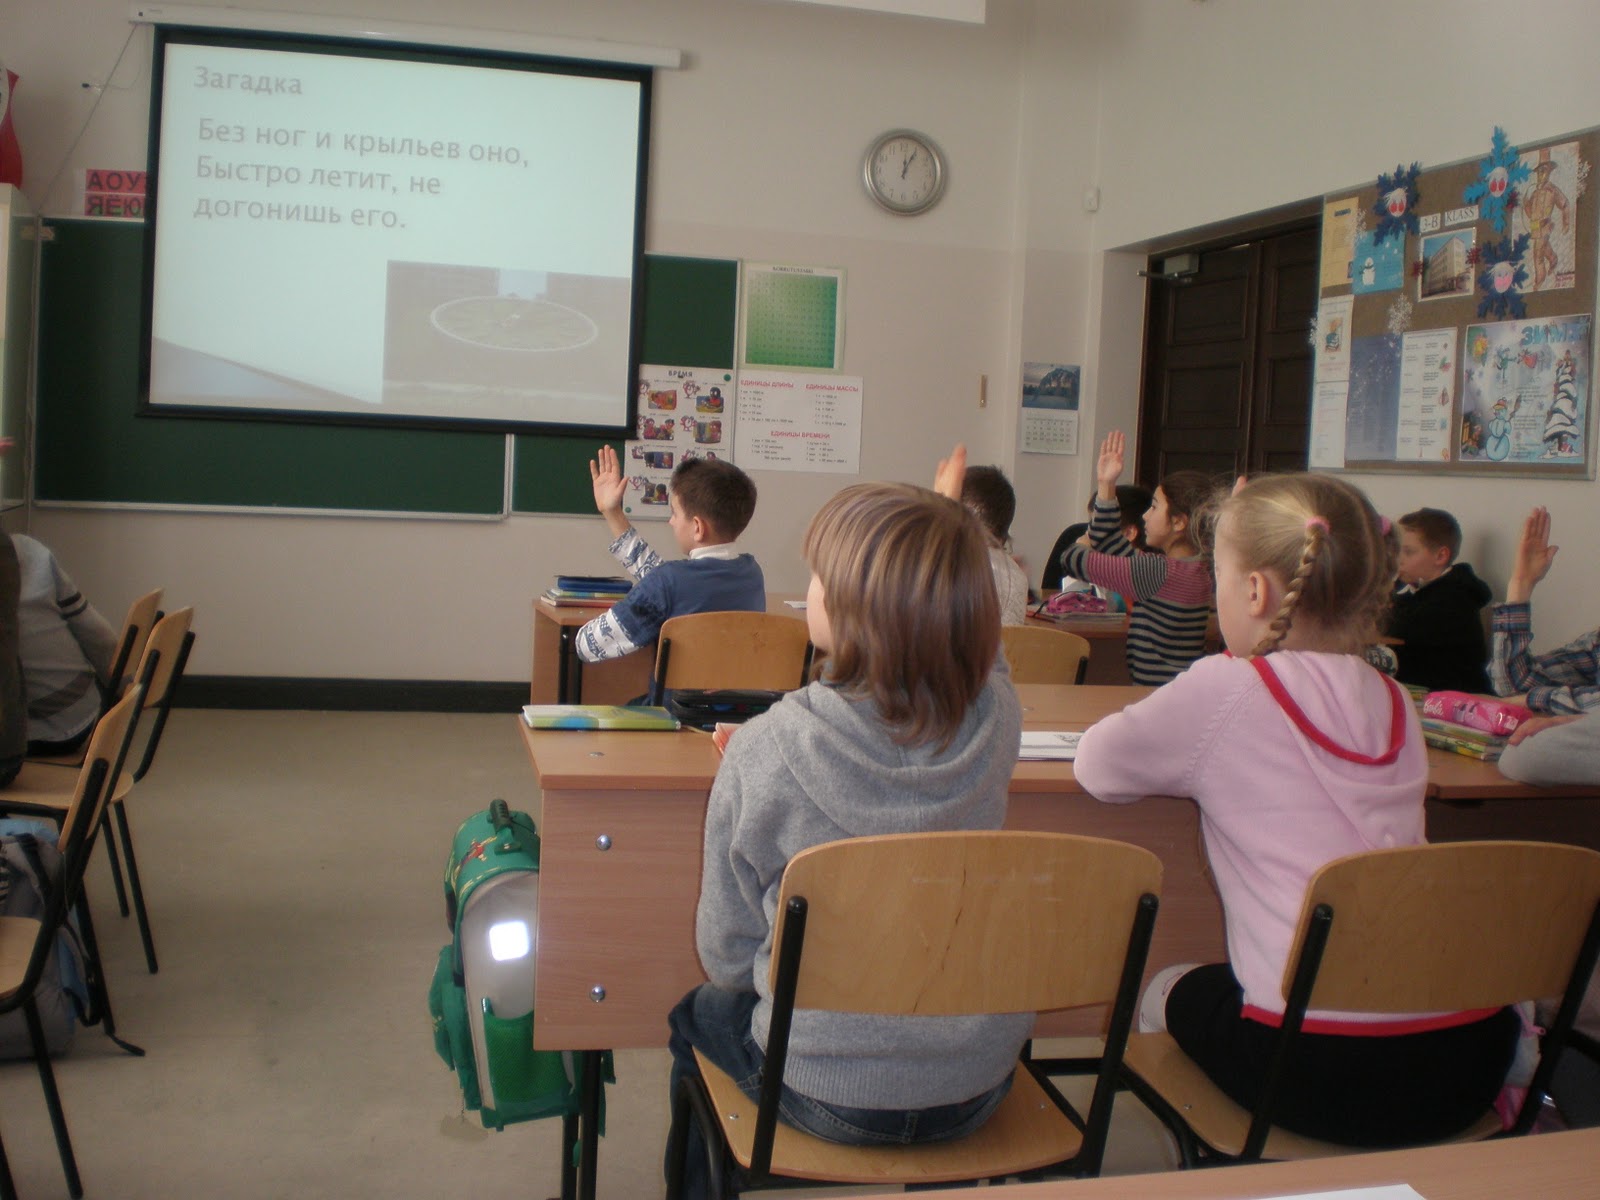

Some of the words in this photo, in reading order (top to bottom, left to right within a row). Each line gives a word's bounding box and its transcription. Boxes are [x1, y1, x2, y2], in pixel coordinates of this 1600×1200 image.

[194, 66, 303, 95] Загадка
[199, 118, 245, 143] Без
[256, 127, 306, 146] ног
[316, 131, 331, 149] и
[343, 133, 461, 159] крыльев
[469, 144, 528, 168] оно,
[196, 155, 301, 187] Быстро
[309, 168, 397, 194] летит,
[409, 176, 441, 194] не
[193, 198, 342, 224] догонишь
[351, 208, 406, 228] его.
